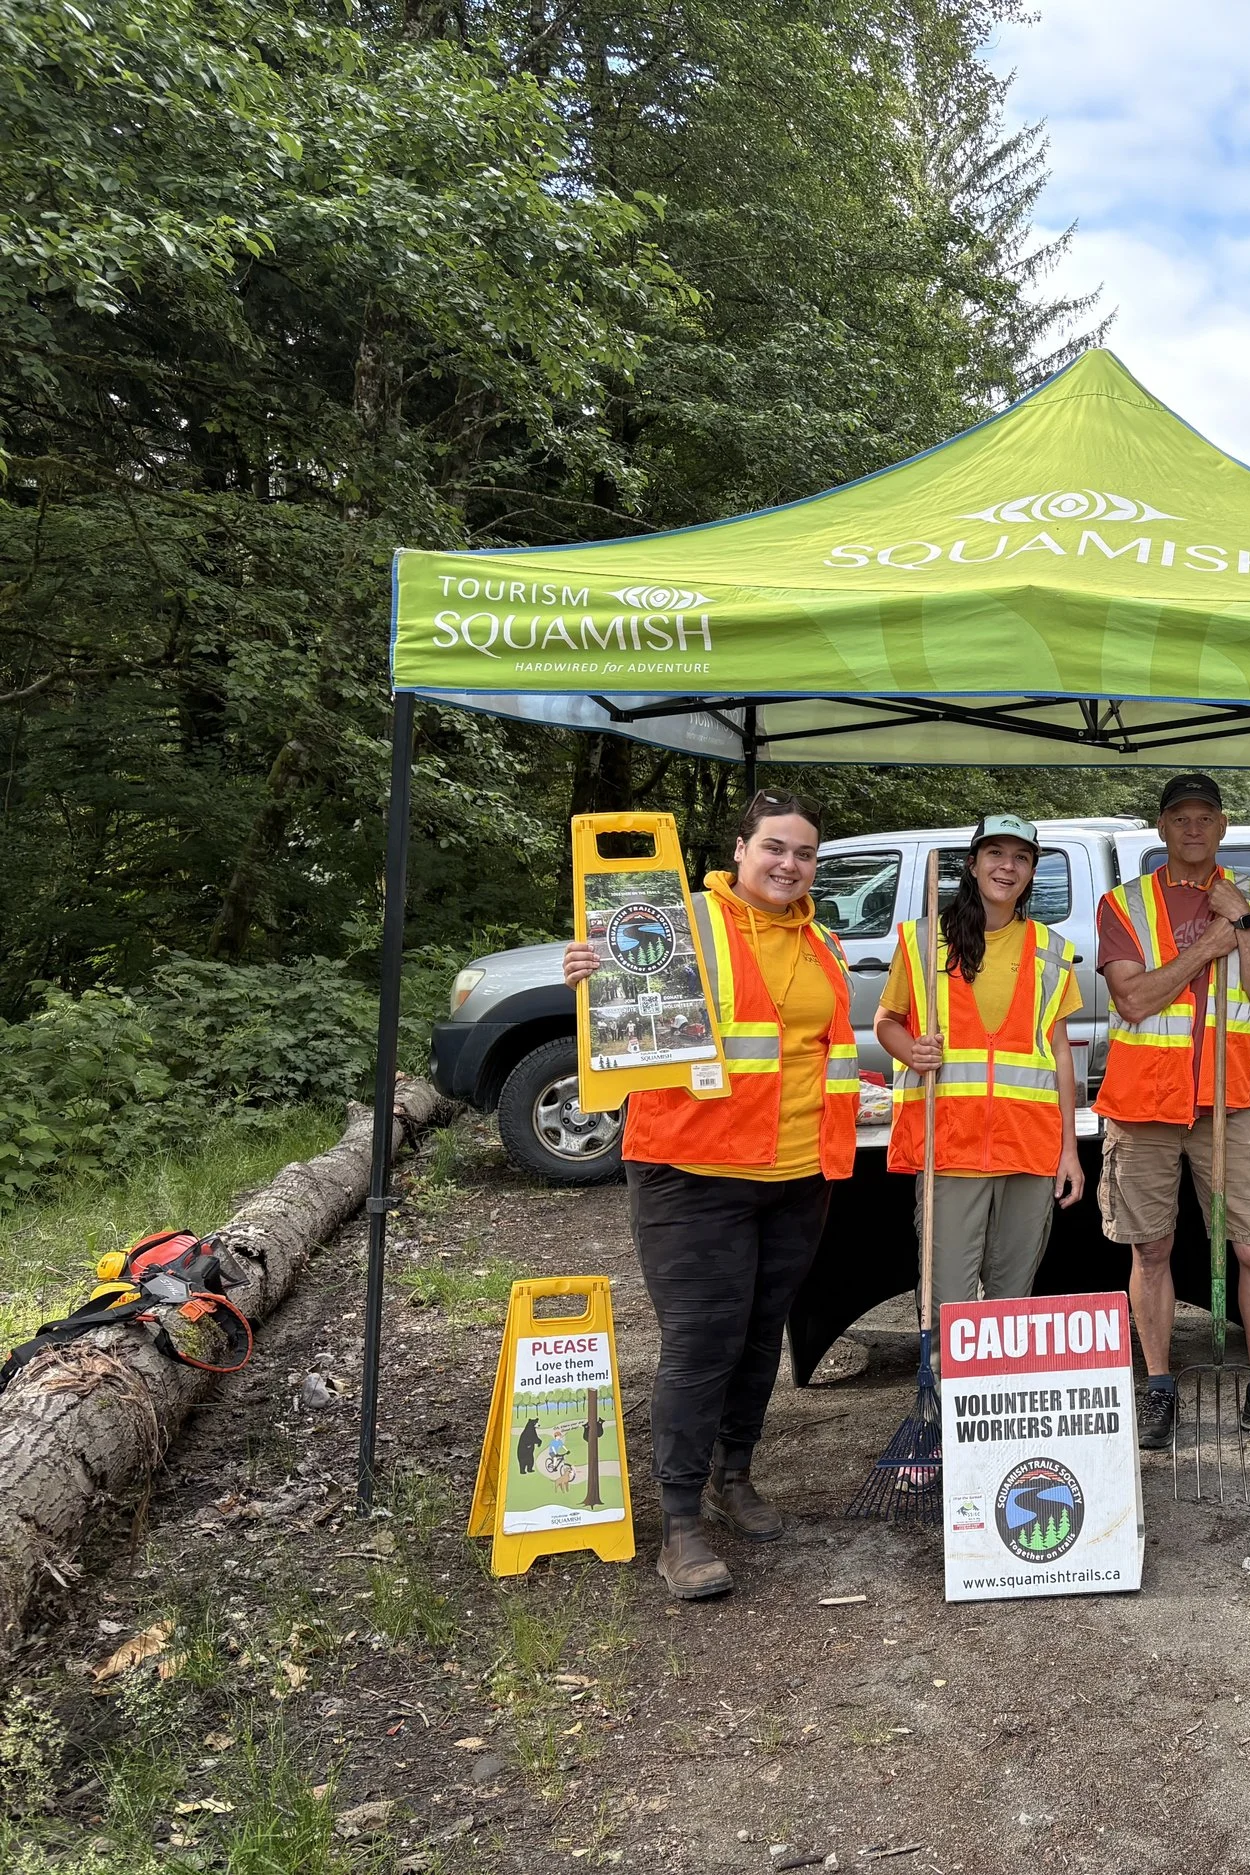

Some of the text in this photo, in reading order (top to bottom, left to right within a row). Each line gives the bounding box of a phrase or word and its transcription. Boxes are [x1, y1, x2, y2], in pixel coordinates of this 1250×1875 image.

[438, 575, 590, 607] TOURISM
[432, 610, 713, 659] SQUAMISH
[515, 661, 711, 674] HARDWIRED for ADVENTURE
[611, 906, 672, 946] SQUAMISH TRAILS SOCIETY
[160, 1278, 181, 1296] STIHL
[532, 1338, 598, 1356] PLEASE
[949, 1309, 1121, 1362] CAUTION
[520, 1370, 609, 1386] and leash them!
[536, 1358, 594, 1371] Love them
[954, 1386, 1121, 1418] VOLUNTEER TRAIL
[956, 1412, 1120, 1443] WORKERS AHEAD
[997, 1460, 1083, 1509] SQUAMISH TRAILS SOCIETY
[1009, 1532, 1076, 1561] Together on trails
[963, 1568, 1121, 1590] www.squamishtrails.ca
